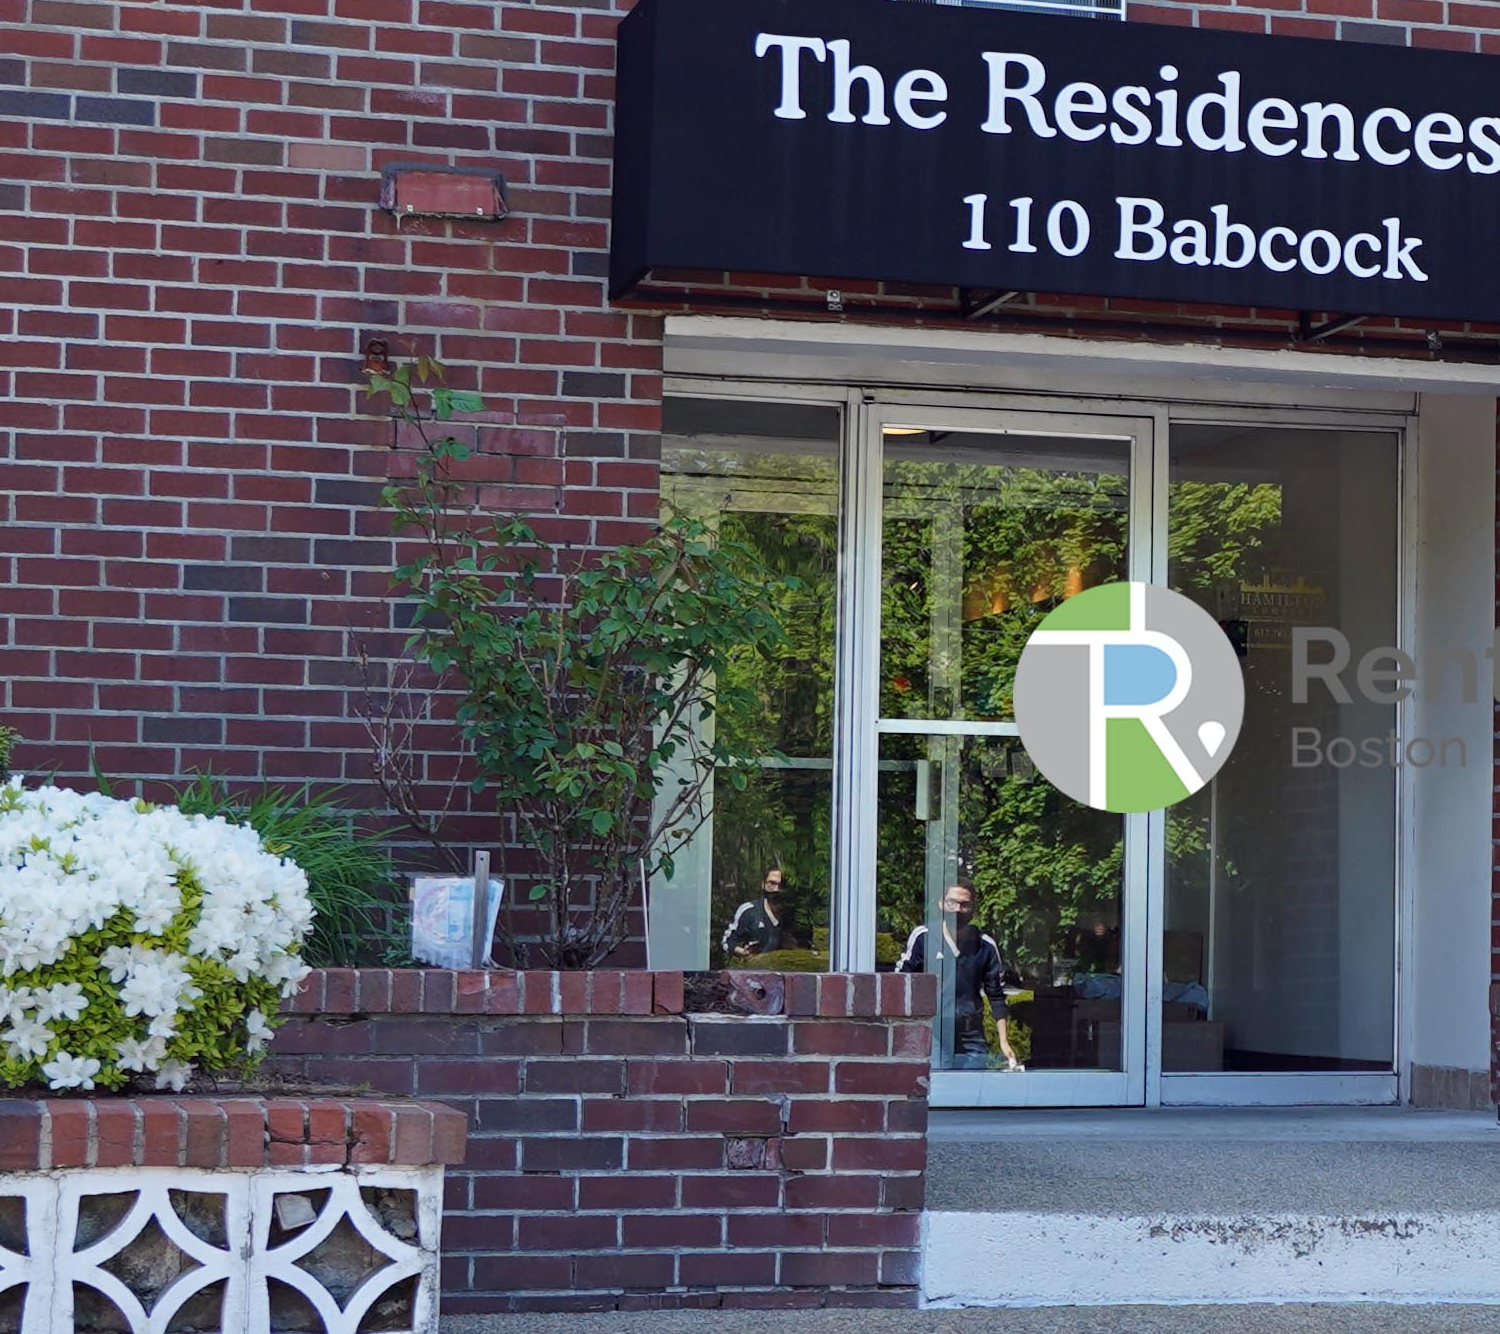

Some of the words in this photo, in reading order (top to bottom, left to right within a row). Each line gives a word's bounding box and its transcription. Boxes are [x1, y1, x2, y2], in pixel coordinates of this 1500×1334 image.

[756, 33, 947, 130] The
[963, 194, 1090, 256] 110
[1115, 197, 1429, 282] Babcock
